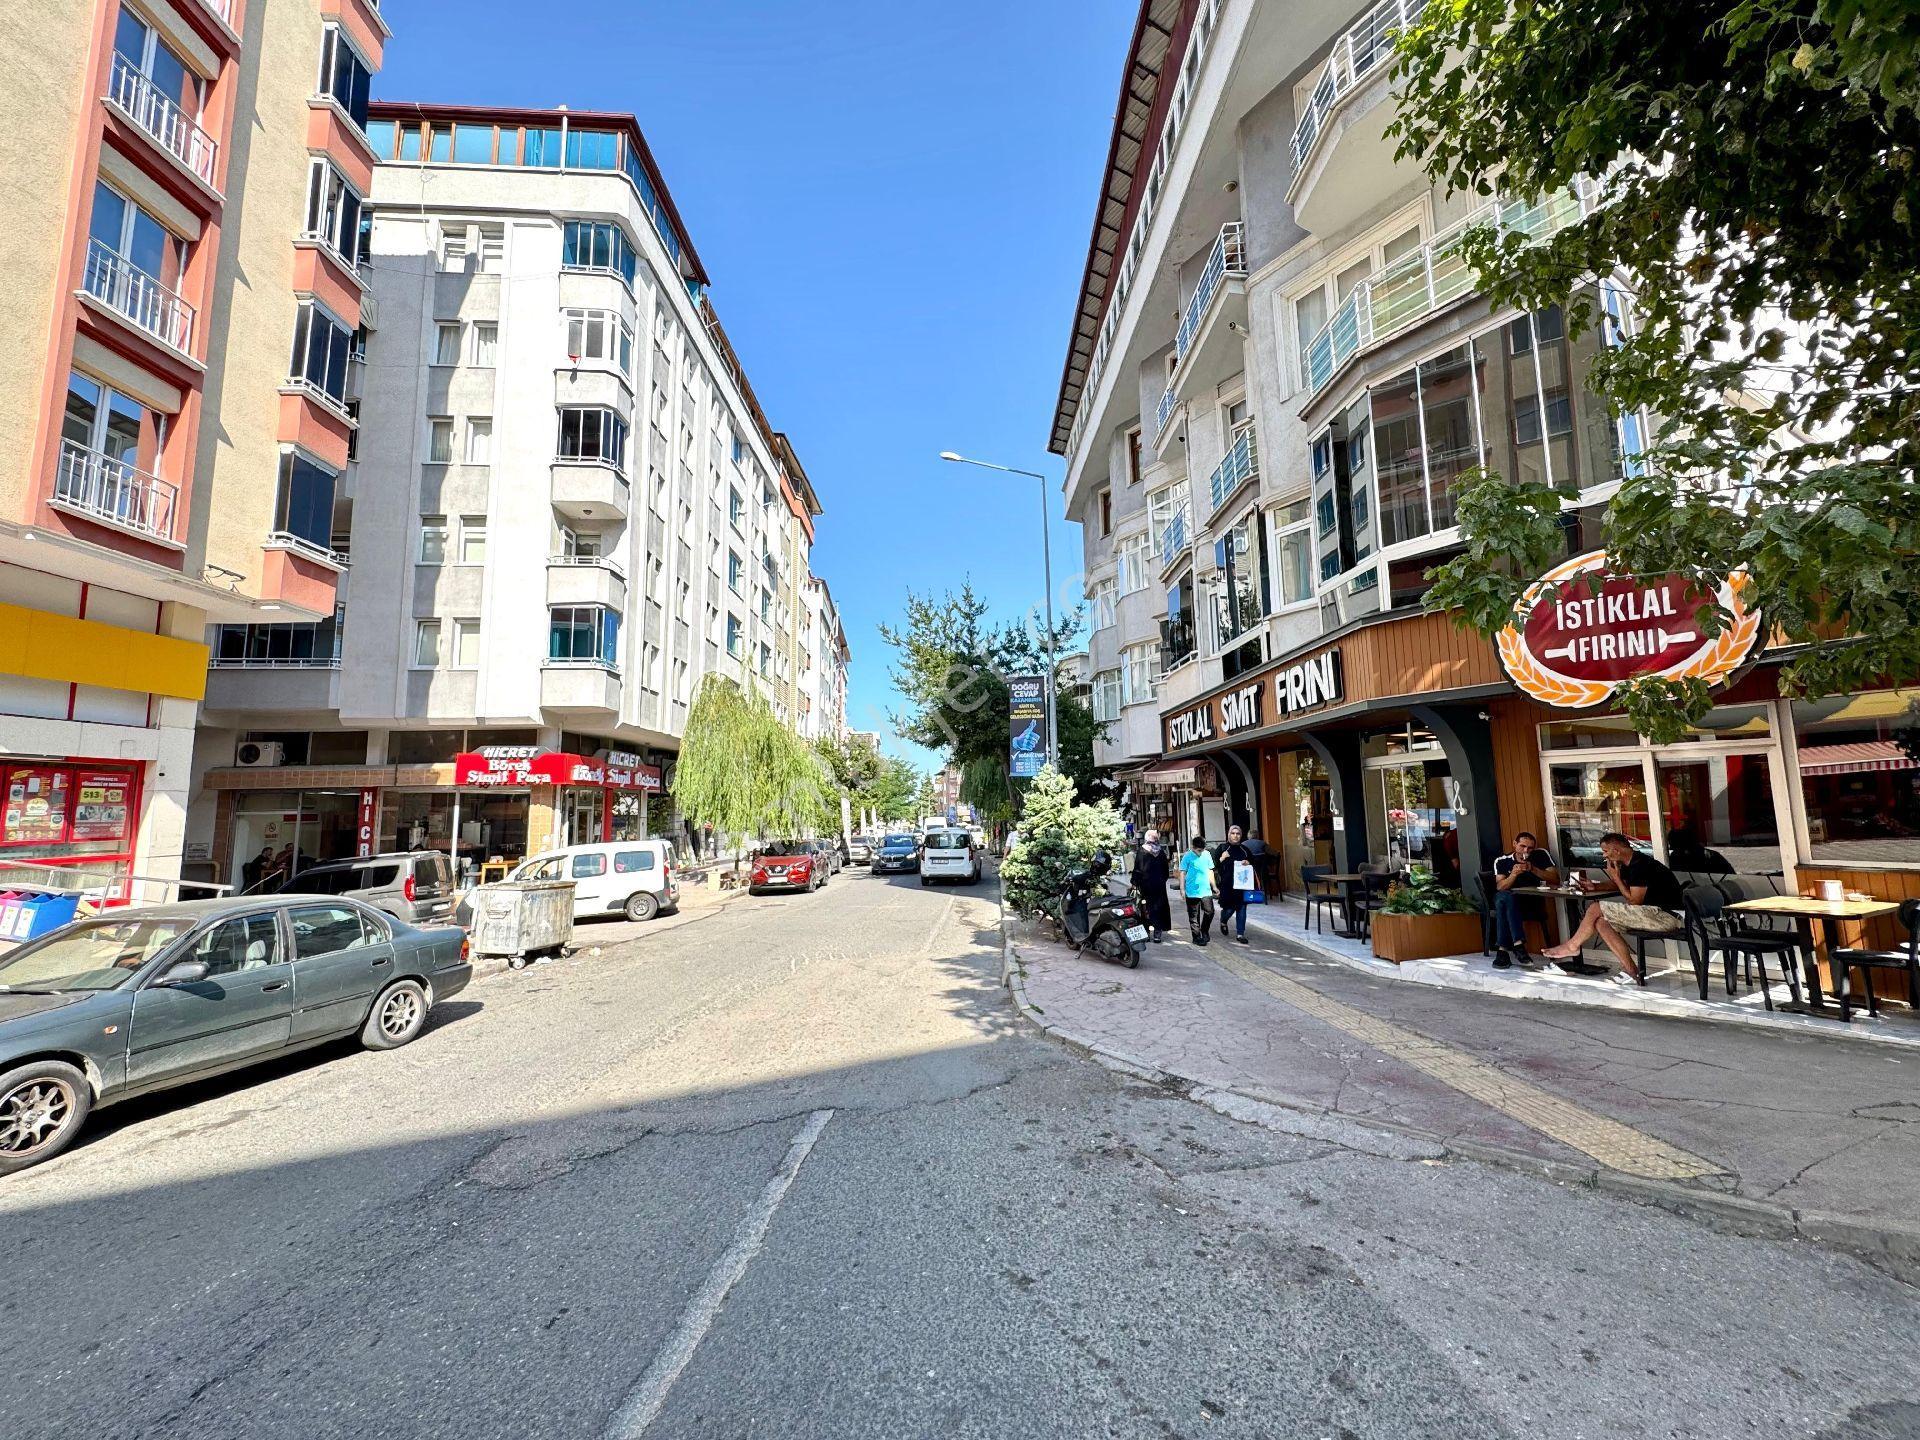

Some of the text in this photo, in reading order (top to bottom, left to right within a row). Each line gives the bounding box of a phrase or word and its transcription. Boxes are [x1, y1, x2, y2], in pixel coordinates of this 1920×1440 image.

[1556, 586, 1677, 631] İSTİKLAL
[1578, 628, 1655, 662] FIRINI
[1011, 682, 1039, 691] DOĞRU
[1013, 690, 1039, 698] CEVAP
[1169, 650, 1337, 748] İSTİKLAL SİMİT FIRINI
[483, 747, 539, 758] HİCRET
[608, 751, 640, 768] HİCRET
[488, 759, 532, 772] Börek
[360, 791, 373, 857] HİCR
